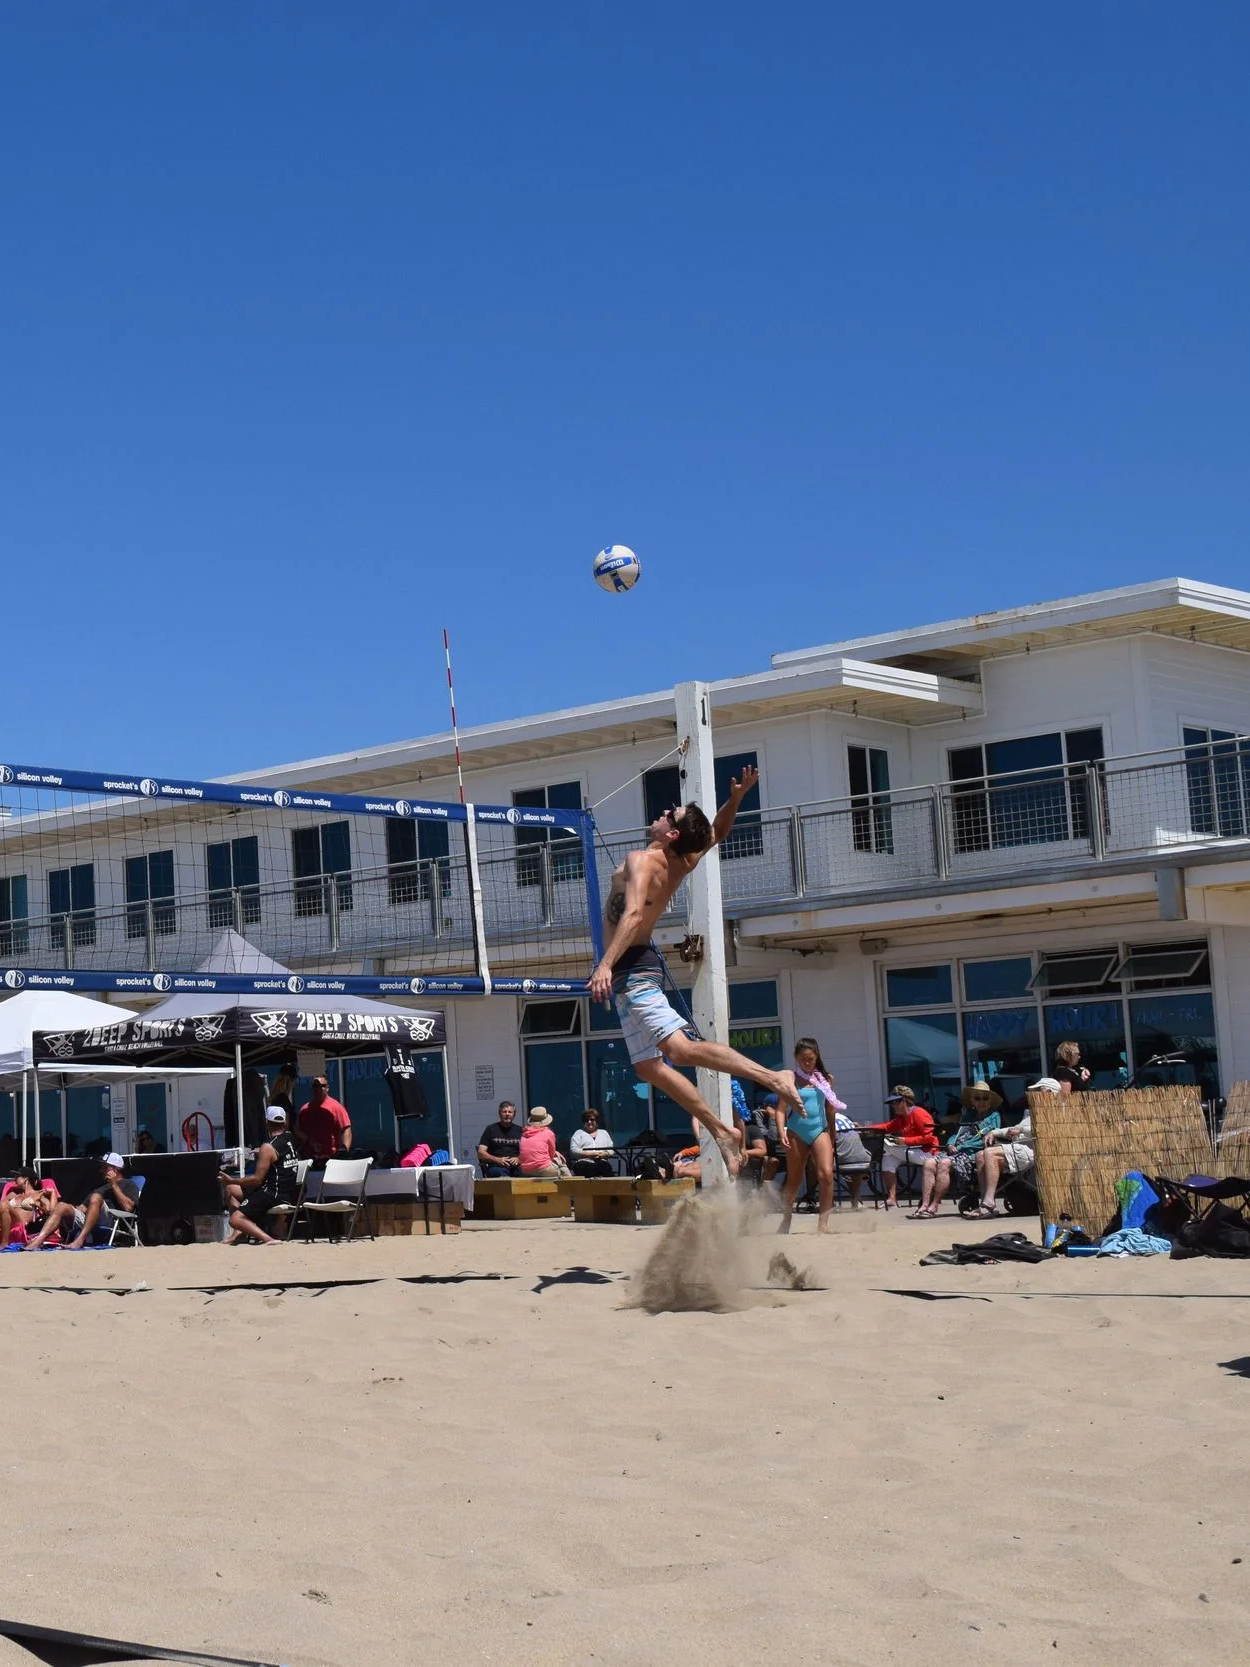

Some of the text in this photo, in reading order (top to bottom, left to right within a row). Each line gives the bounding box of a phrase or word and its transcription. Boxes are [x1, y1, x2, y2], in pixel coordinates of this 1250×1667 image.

[16, 771, 41, 782] silicon
[41, 774, 63, 786] volley
[103, 781, 204, 798] sprocket's silicon volley
[240, 793, 332, 808] sprocket's silicon volley
[365, 803, 448, 817] sprocket's silicon volley
[478, 811, 555, 823] sprocket's silicon volley
[28, 975, 53, 984] silicon
[53, 975, 75, 986] volley
[115, 977, 217, 989] sprocket's silicon volley
[253, 980, 346, 991] sprocket's silicon volley
[296, 1011, 399, 1034] 2DEEP SPORTS
[82, 1017, 186, 1047] 2DEEP SPORTS
